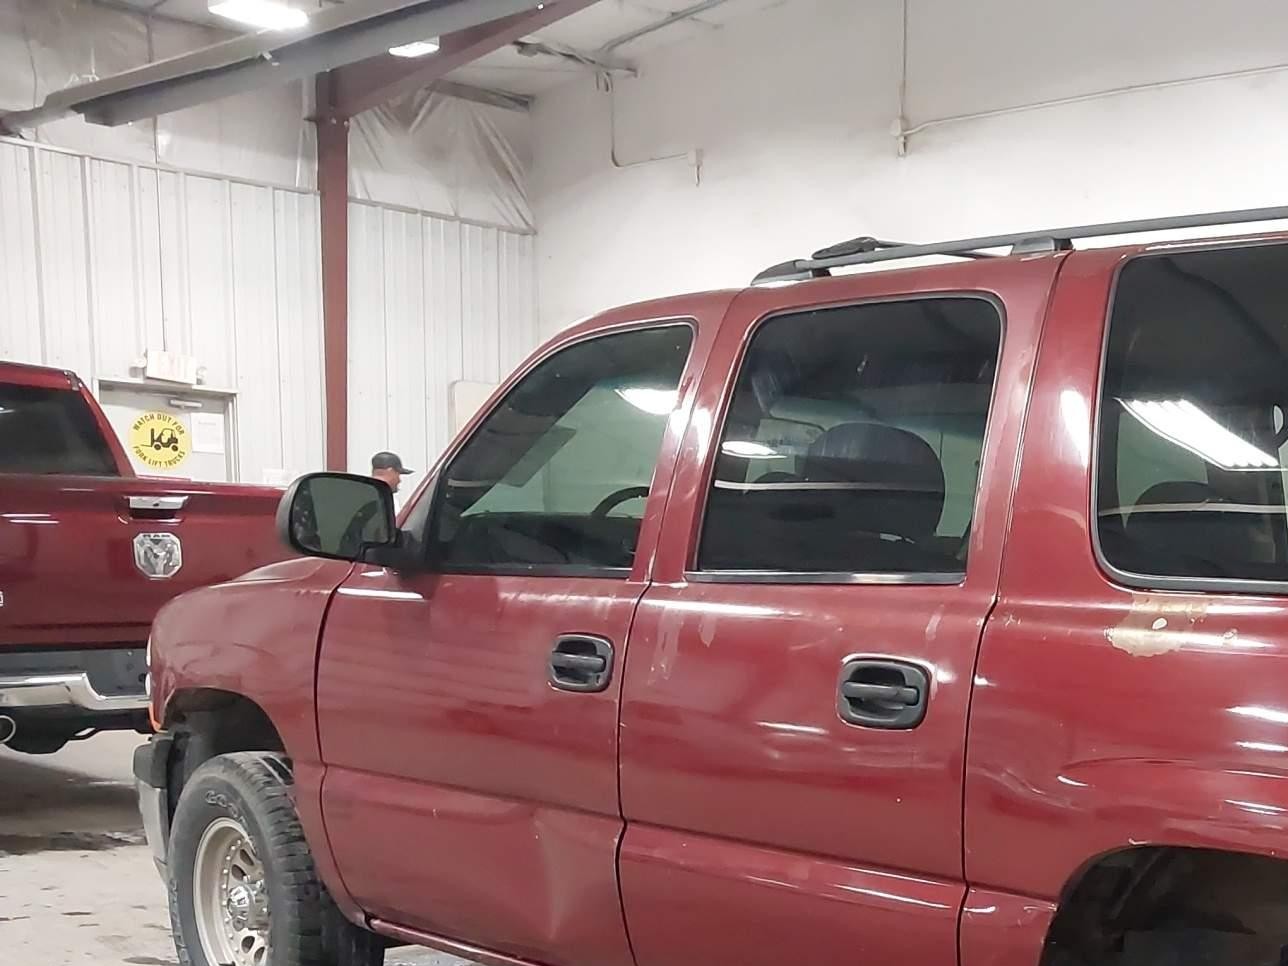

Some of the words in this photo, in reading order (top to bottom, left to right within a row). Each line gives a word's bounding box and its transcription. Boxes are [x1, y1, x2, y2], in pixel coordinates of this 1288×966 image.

[133, 413, 155, 431] WATCH
[156, 413, 172, 423] OUT
[171, 420, 185, 435] FOR
[132, 445, 148, 462] FORK
[148, 458, 162, 468] LIFT
[163, 450, 186, 468] TRUCKS
